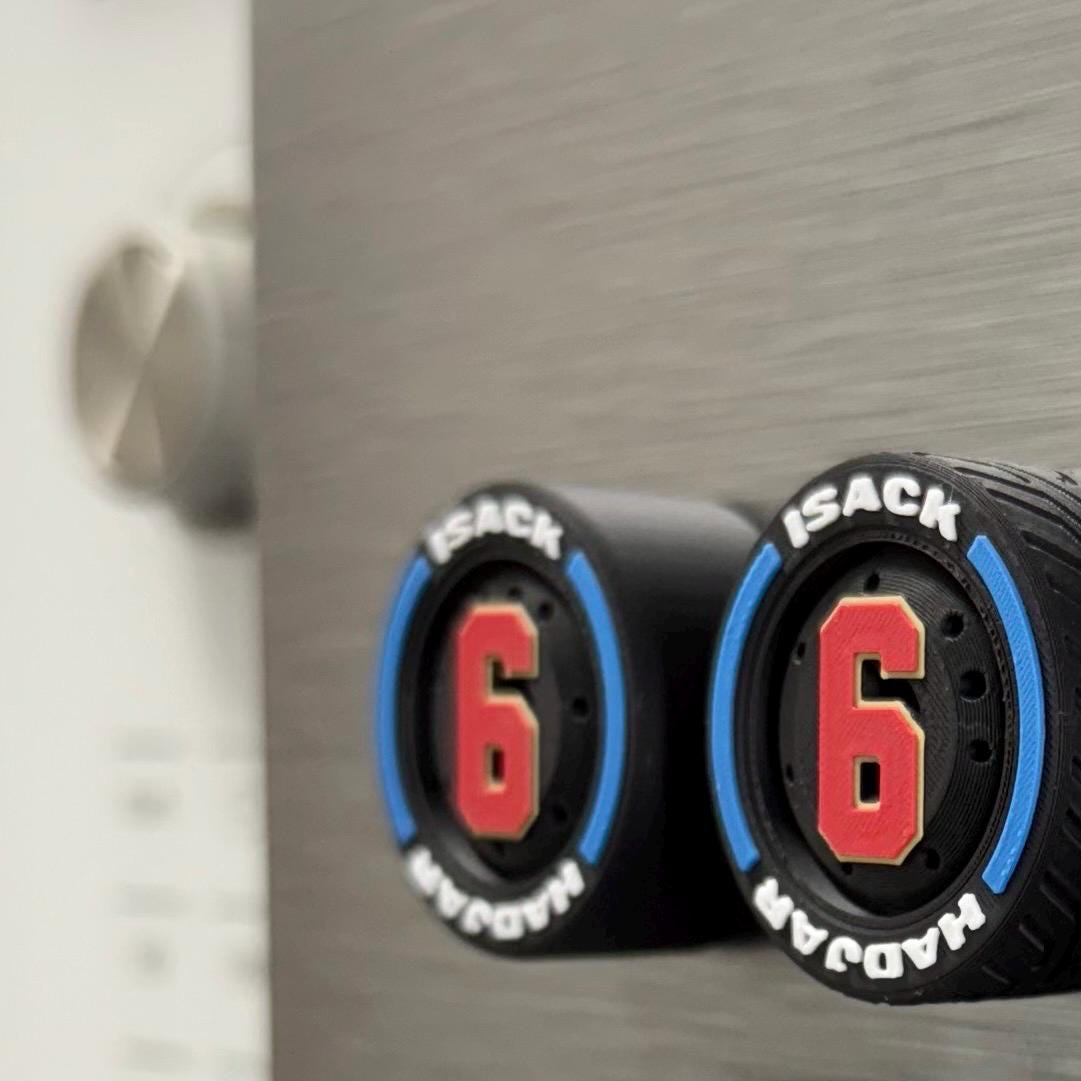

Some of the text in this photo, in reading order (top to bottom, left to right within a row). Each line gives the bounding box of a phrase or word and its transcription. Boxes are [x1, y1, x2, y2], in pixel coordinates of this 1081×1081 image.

[425, 494, 563, 562] ISACK
[781, 475, 961, 548] ISACK
[453, 602, 539, 839] 6
[816, 595, 926, 866] 6
[404, 848, 585, 940] HADJAR
[753, 877, 986, 980] HADJAR
